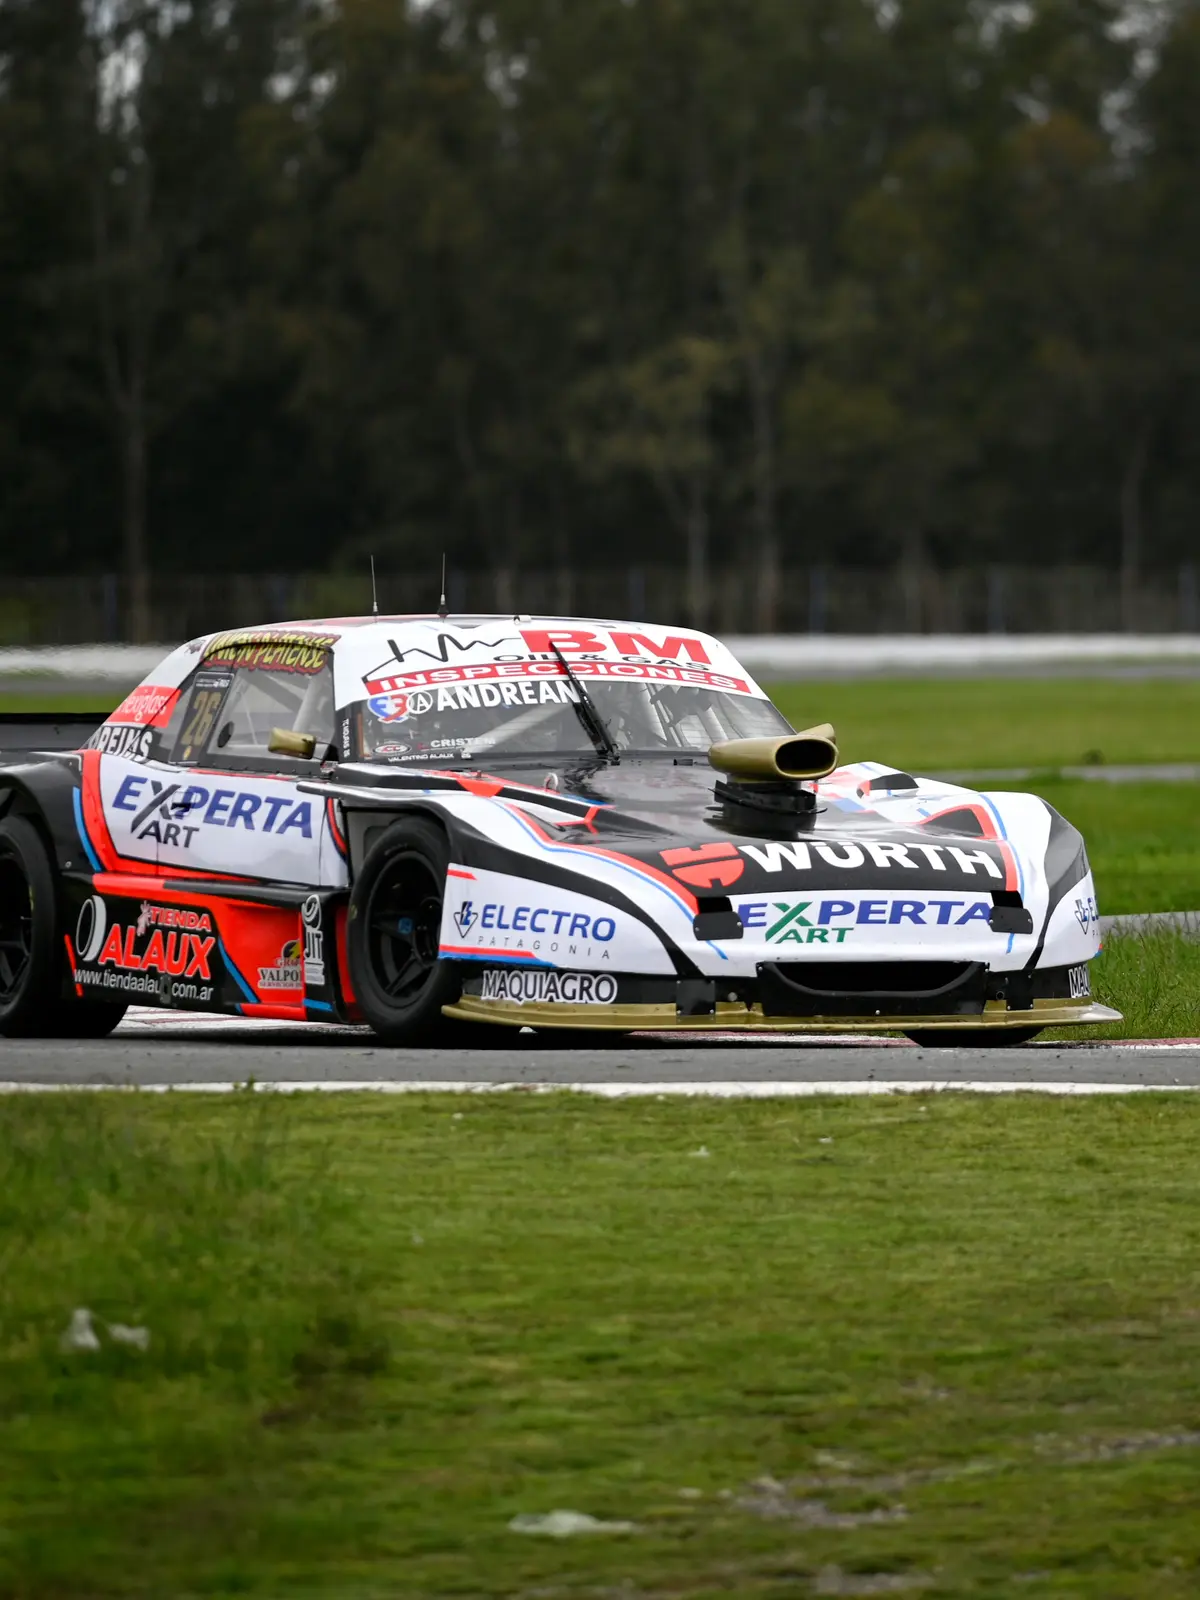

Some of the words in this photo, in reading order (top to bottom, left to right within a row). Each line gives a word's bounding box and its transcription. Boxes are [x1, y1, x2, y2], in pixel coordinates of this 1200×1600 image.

[519, 630, 712, 665] BM
[380, 661, 738, 691] INSPECCIONES
[622, 655, 710, 671] GAS
[387, 754, 429, 763] VALENTINO
[111, 775, 313, 839] EXPERTA
[137, 820, 200, 849] ART
[150, 905, 212, 932] TIENDA
[481, 904, 616, 942] ELECTRO
[737, 900, 992, 942] EXPERTA
[477, 935, 610, 960] PATAGONIA
[775, 927, 854, 944] ART
[98, 923, 215, 980] ALAUX
[74, 968, 214, 1001] www.tiendaalaucom.ar
[260, 969, 302, 982] VALPO
[481, 969, 619, 1005] MAQUIAGRO
